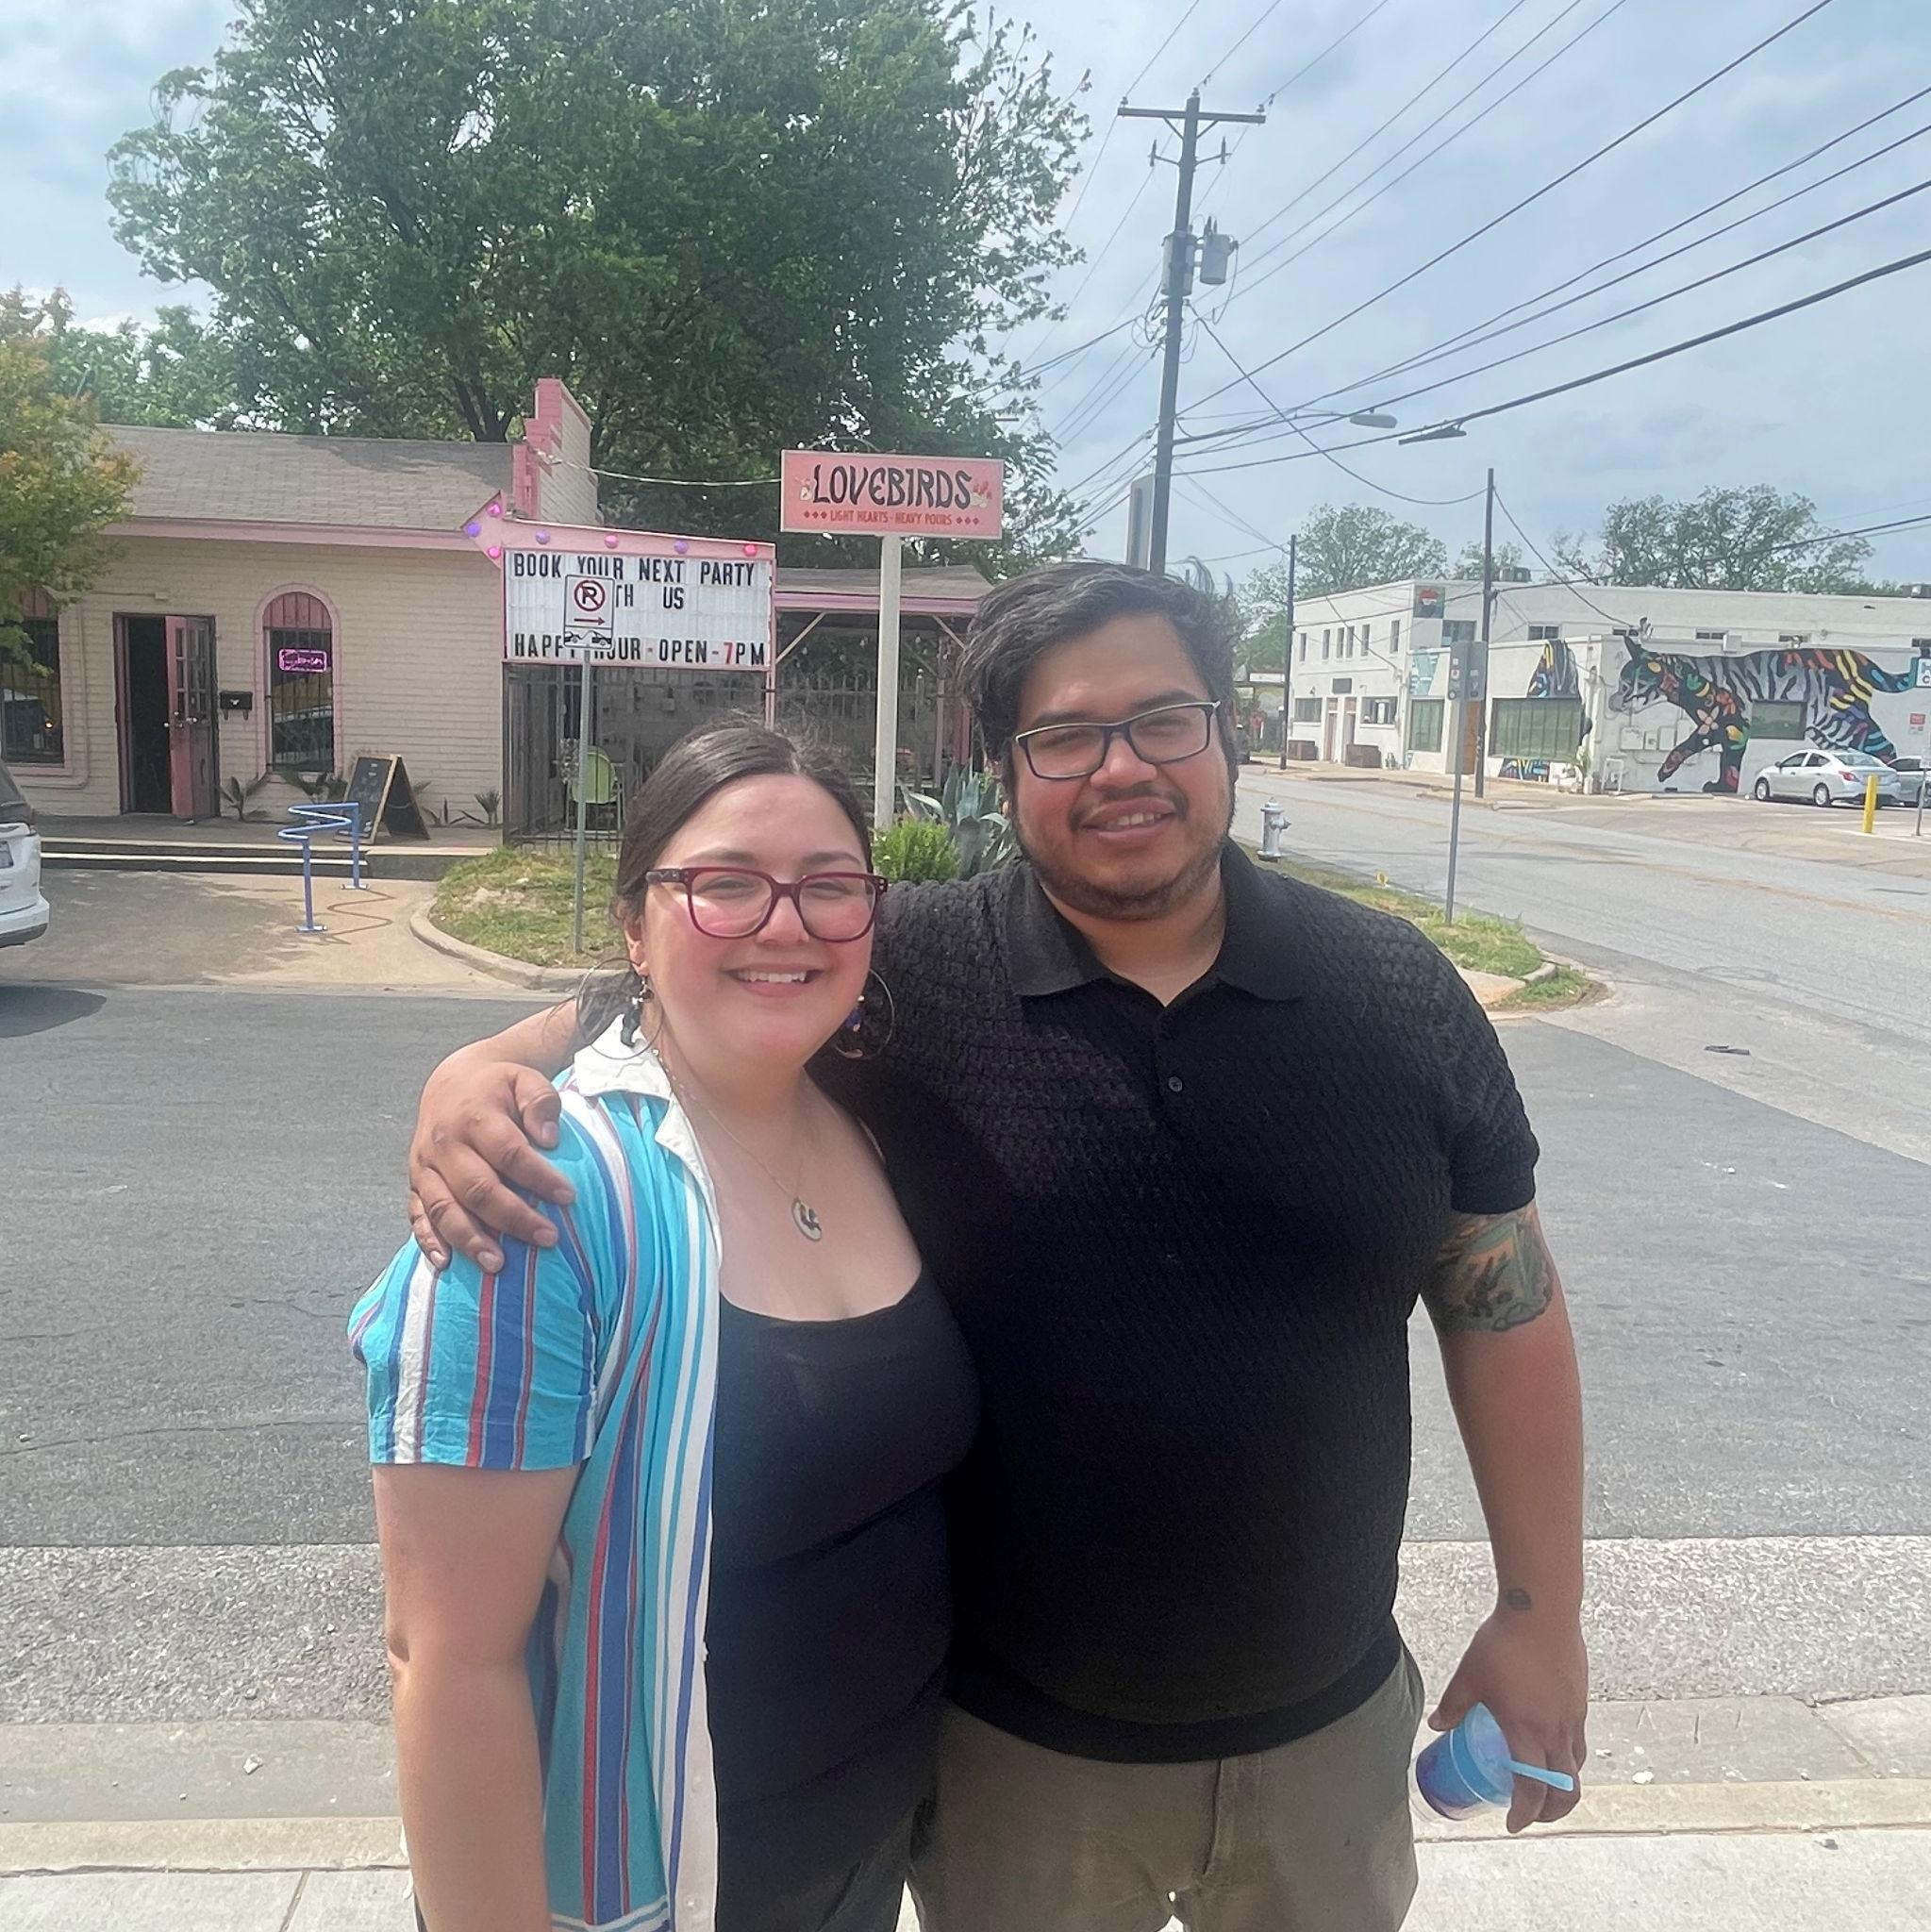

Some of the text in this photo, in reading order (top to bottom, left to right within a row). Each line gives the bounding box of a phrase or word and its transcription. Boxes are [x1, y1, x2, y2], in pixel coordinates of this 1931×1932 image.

[812, 463, 973, 510] LOVEBIRDS
[830, 510, 952, 525] LIGHT HEARTS HEAVY POURS
[513, 553, 755, 587] BOOK YOUR NEXT PARTY
[616, 584, 685, 609] TH US
